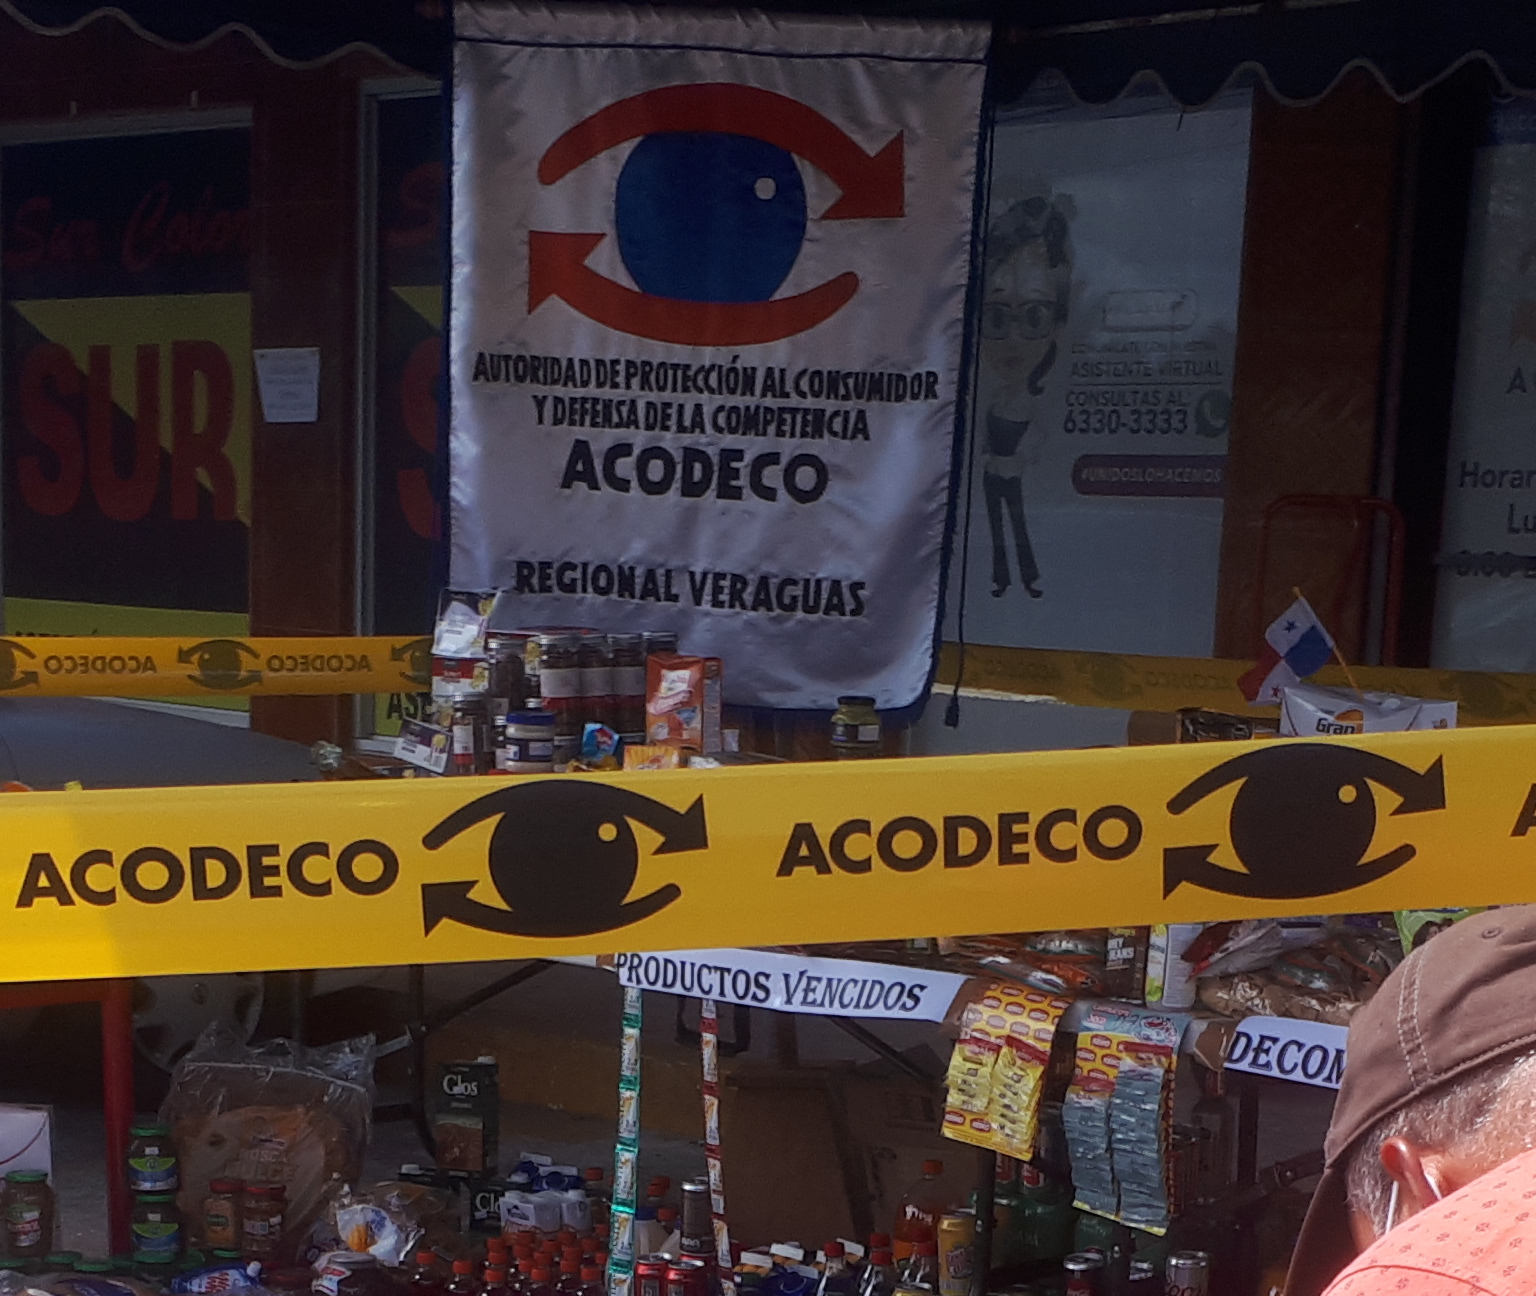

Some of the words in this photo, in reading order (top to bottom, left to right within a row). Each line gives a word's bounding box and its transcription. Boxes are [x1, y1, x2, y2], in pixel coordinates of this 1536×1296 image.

[473, 351, 593, 389] AUTORIDAD
[594, 363, 622, 390] DE
[623, 355, 756, 397] PROTECCIÓN
[764, 367, 789, 399] AL
[792, 368, 938, 402] CONSUMIDOR
[18, 340, 238, 523] SUR
[532, 394, 546, 425] Y
[552, 396, 640, 430] DEFENSA
[644, 403, 674, 433] DE
[675, 404, 707, 434] LA
[712, 405, 869, 441] COMPETENCIA
[1063, 408, 1189, 435] 6330-3333
[560, 439, 828, 504] ACODECO
[515, 560, 679, 603] REGIONAL
[687, 570, 866, 619] VERAGUAS
[775, 804, 1143, 879] ACODECO
[16, 837, 400, 909] ACODECO
[615, 951, 775, 1007] PRODUCTOS
